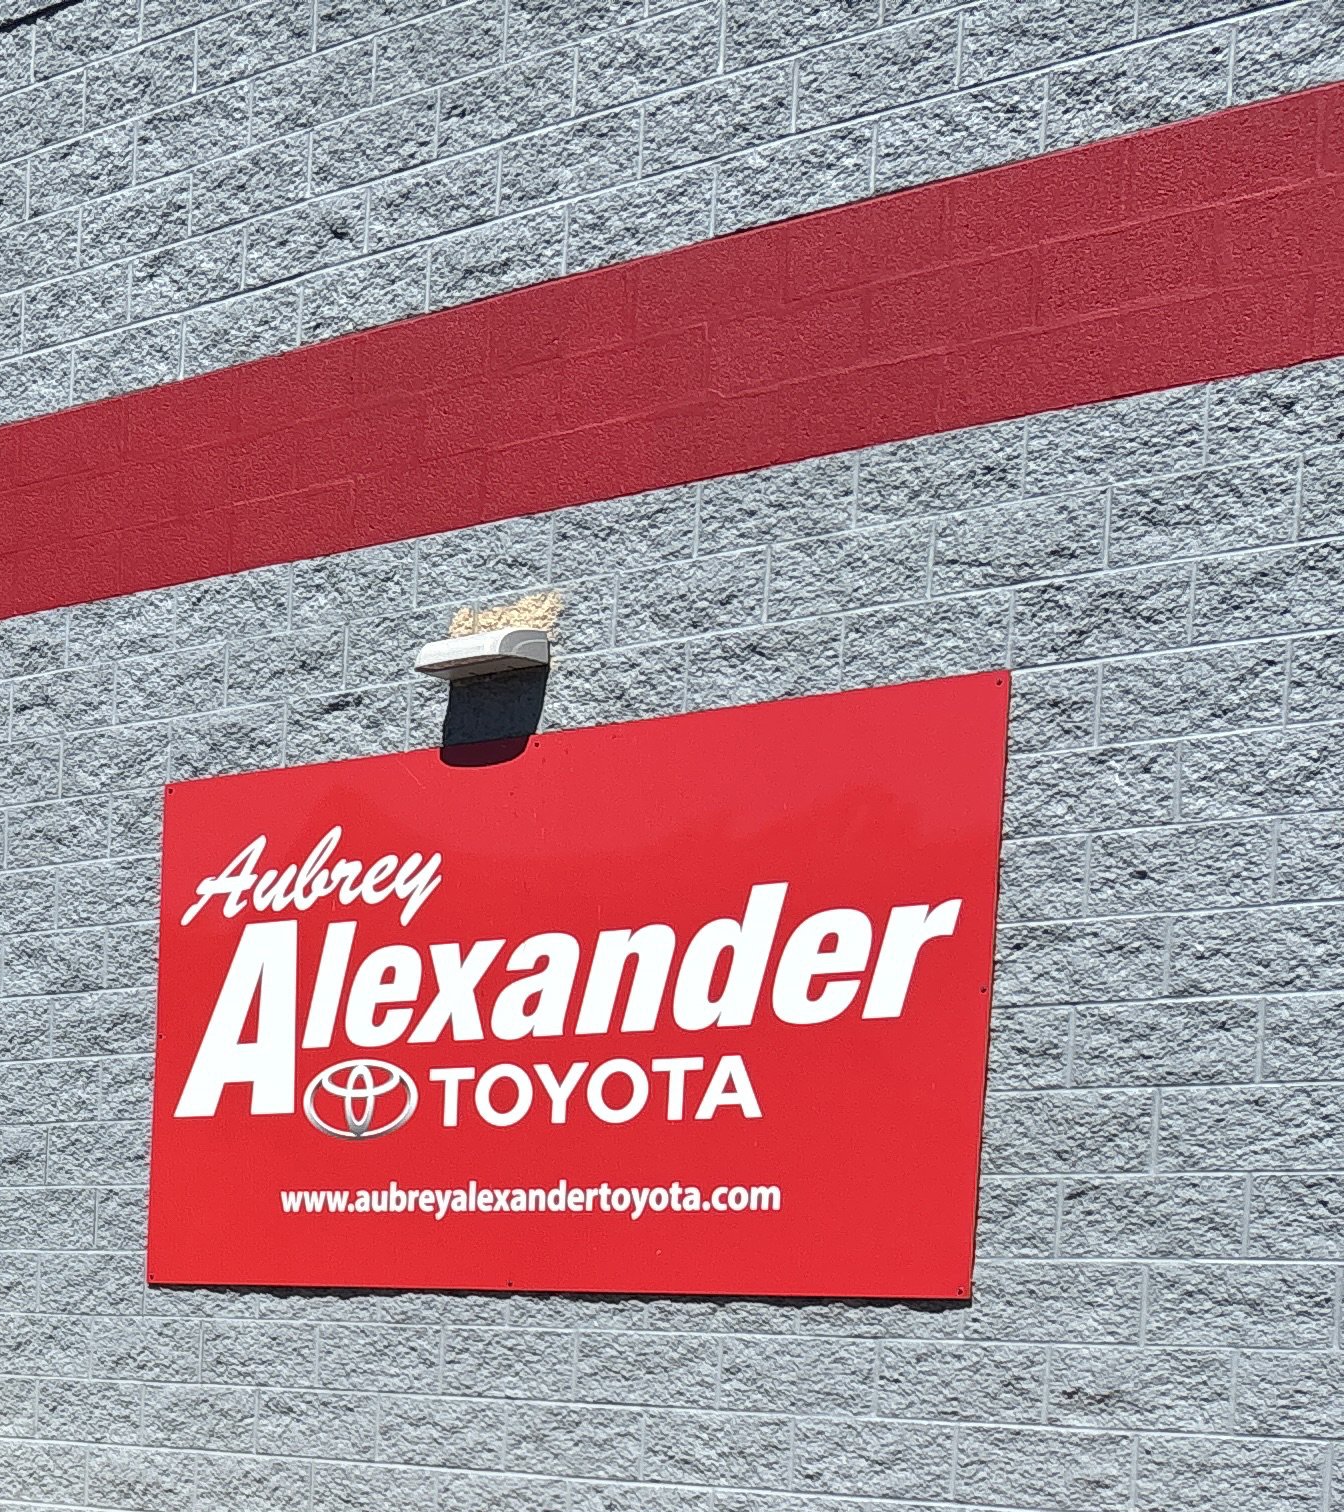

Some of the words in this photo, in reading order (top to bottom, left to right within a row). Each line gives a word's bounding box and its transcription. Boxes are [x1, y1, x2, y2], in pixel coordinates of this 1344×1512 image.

[180, 825, 442, 927] Aubrey
[173, 881, 963, 1118] Alexander
[429, 1054, 763, 1127] TOYOTA
[280, 1179, 781, 1221] www.aubreyalexandertoyota.com
